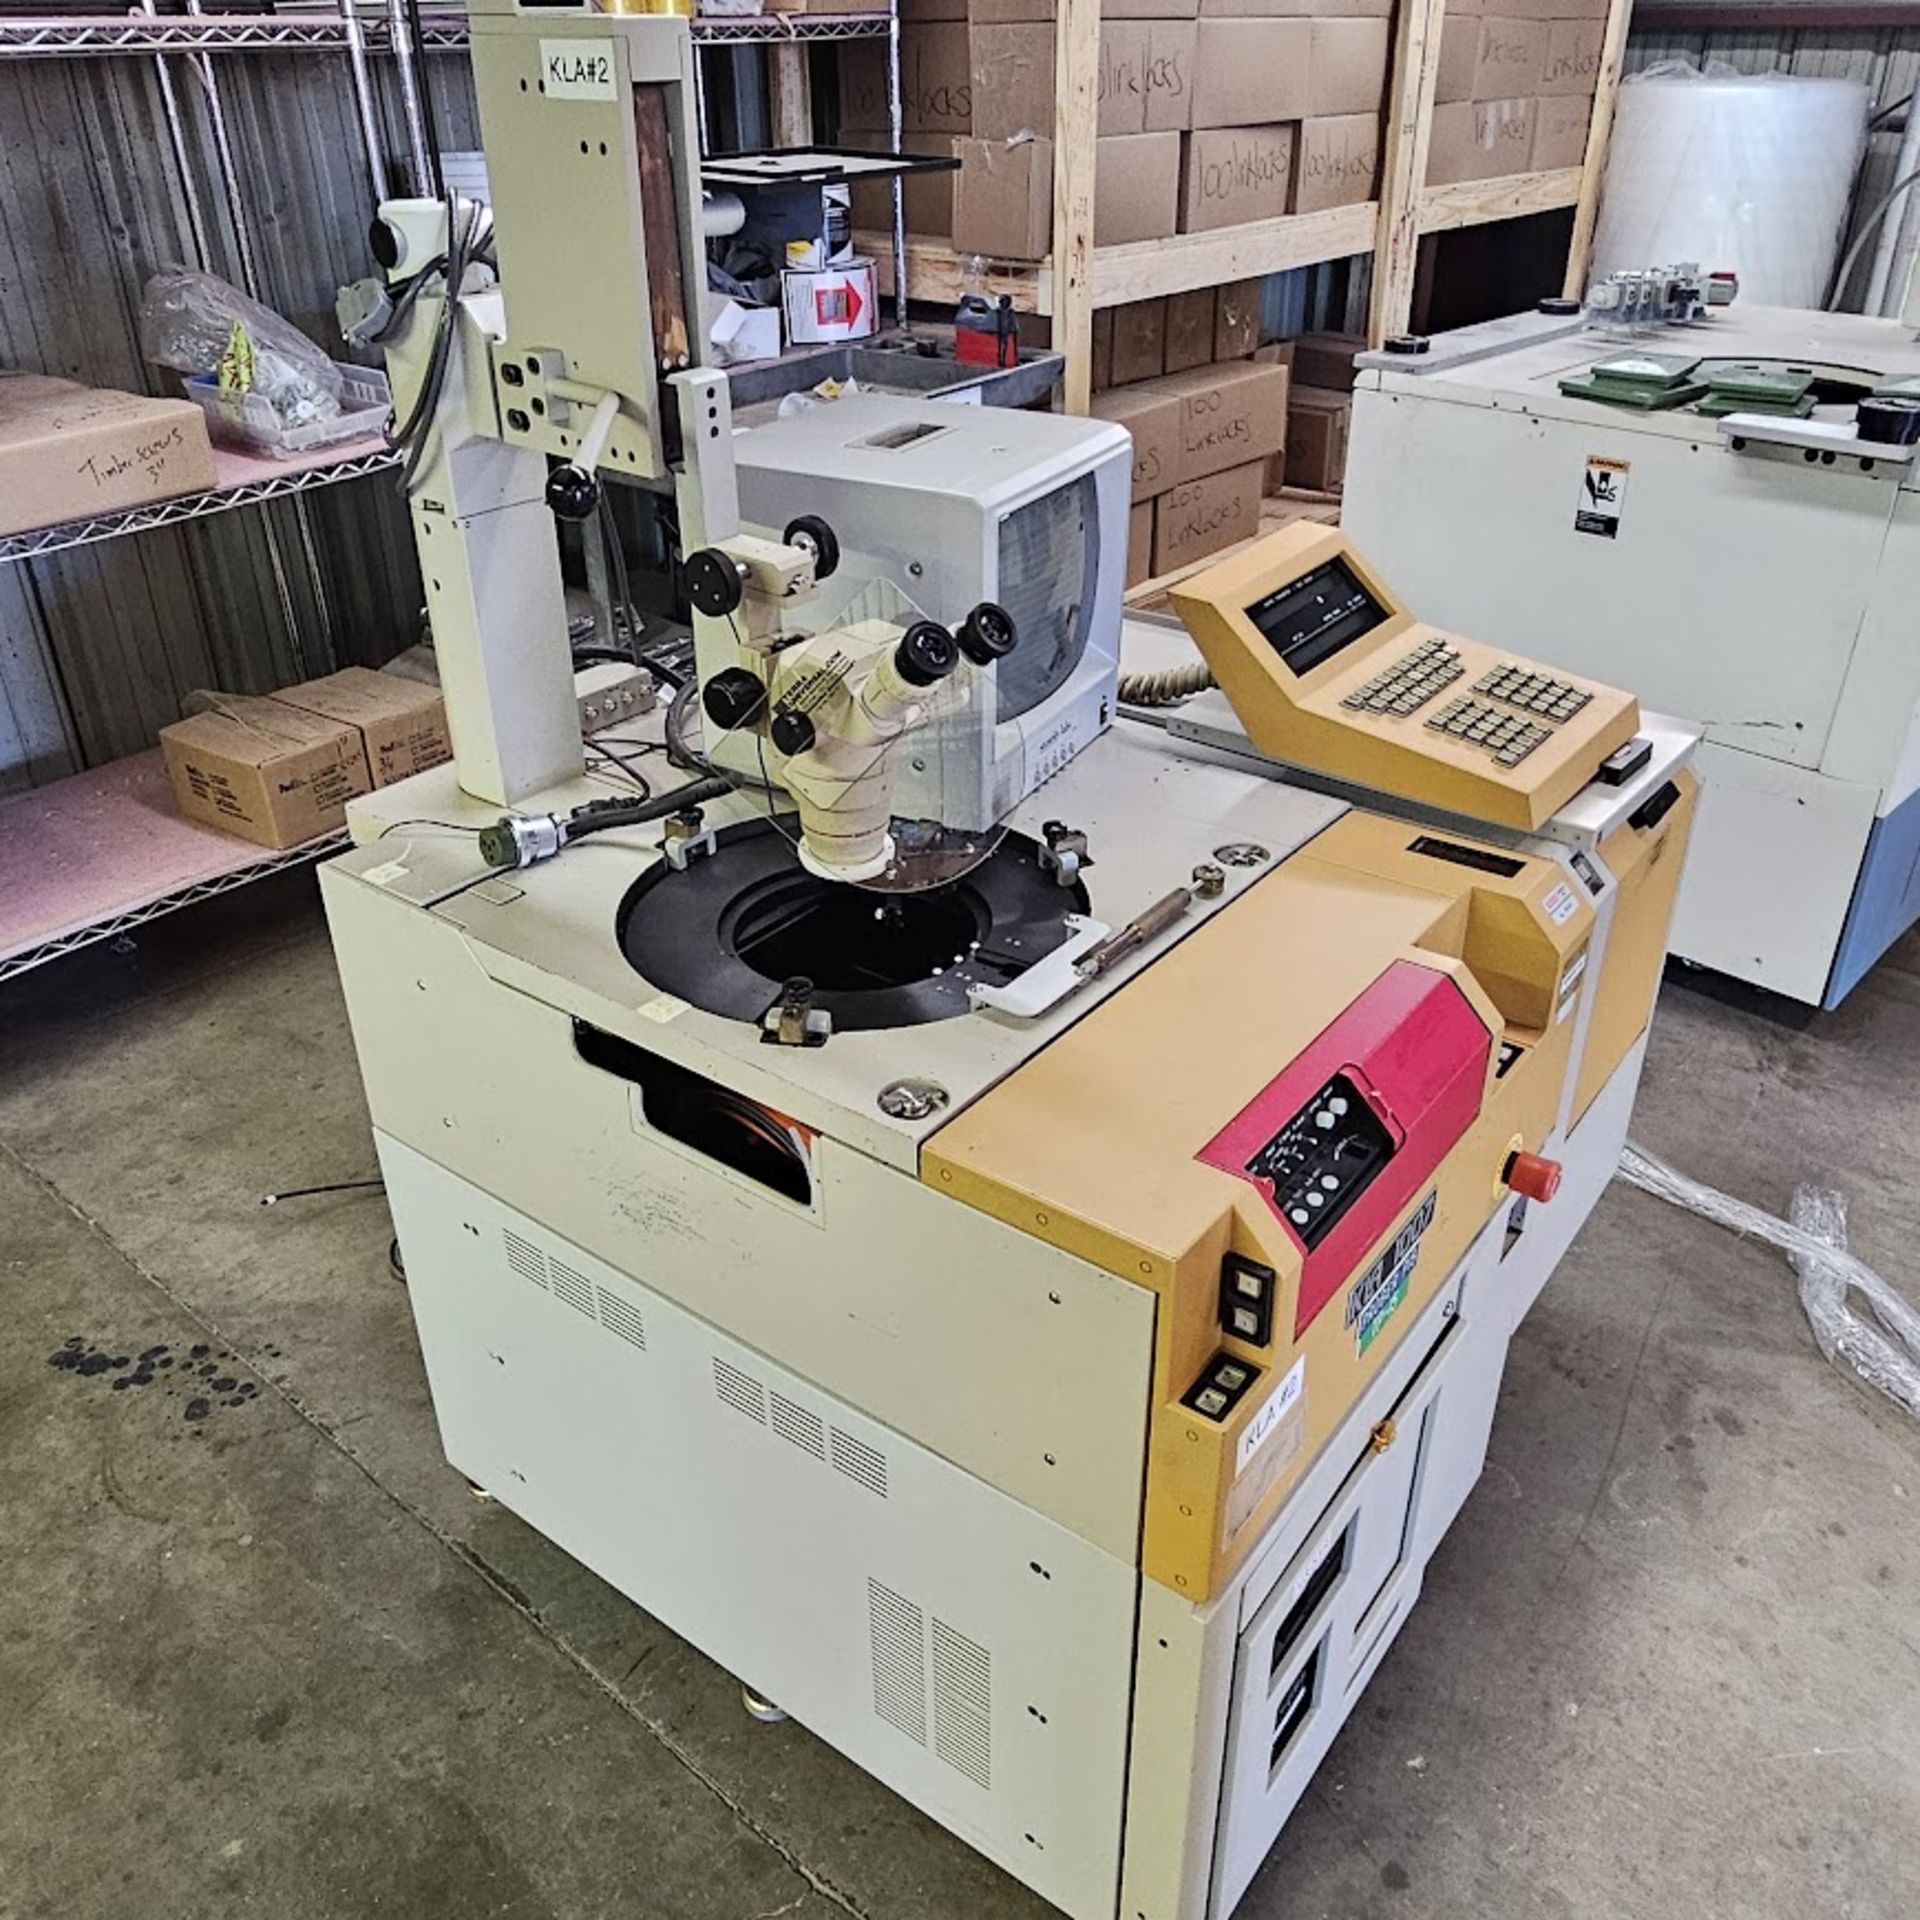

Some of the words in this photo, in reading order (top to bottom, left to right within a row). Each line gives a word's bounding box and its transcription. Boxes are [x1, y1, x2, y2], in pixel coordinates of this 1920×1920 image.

[549, 56, 609, 83] KLA#2
[1186, 390, 1221, 420] 100
[77, 454, 133, 487] Timber
[1169, 485, 1206, 510] 100
[1245, 1404, 1276, 1455] KLA
